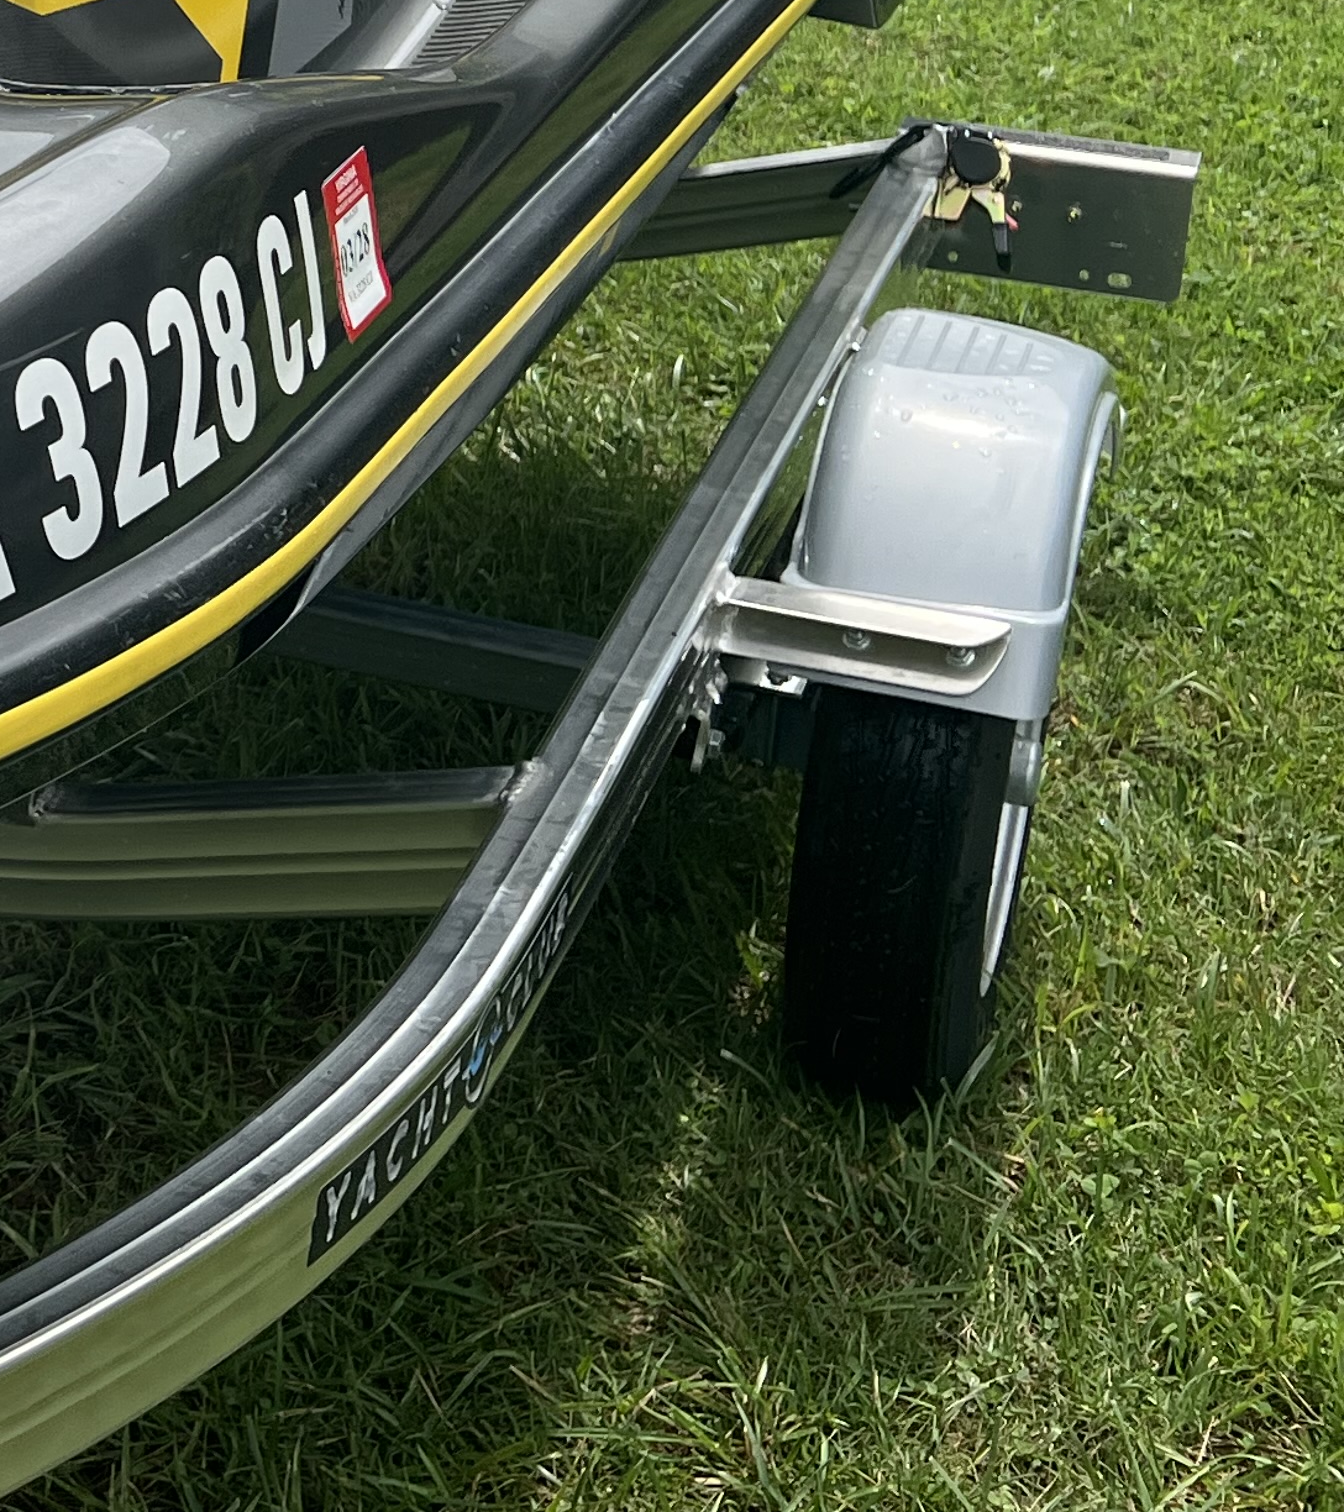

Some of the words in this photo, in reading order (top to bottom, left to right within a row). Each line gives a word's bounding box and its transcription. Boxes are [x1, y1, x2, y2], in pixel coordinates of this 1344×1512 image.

[15, 255, 257, 562] 3228
[256, 190, 329, 397] CJ
[325, 1055, 463, 1244] YACHT
